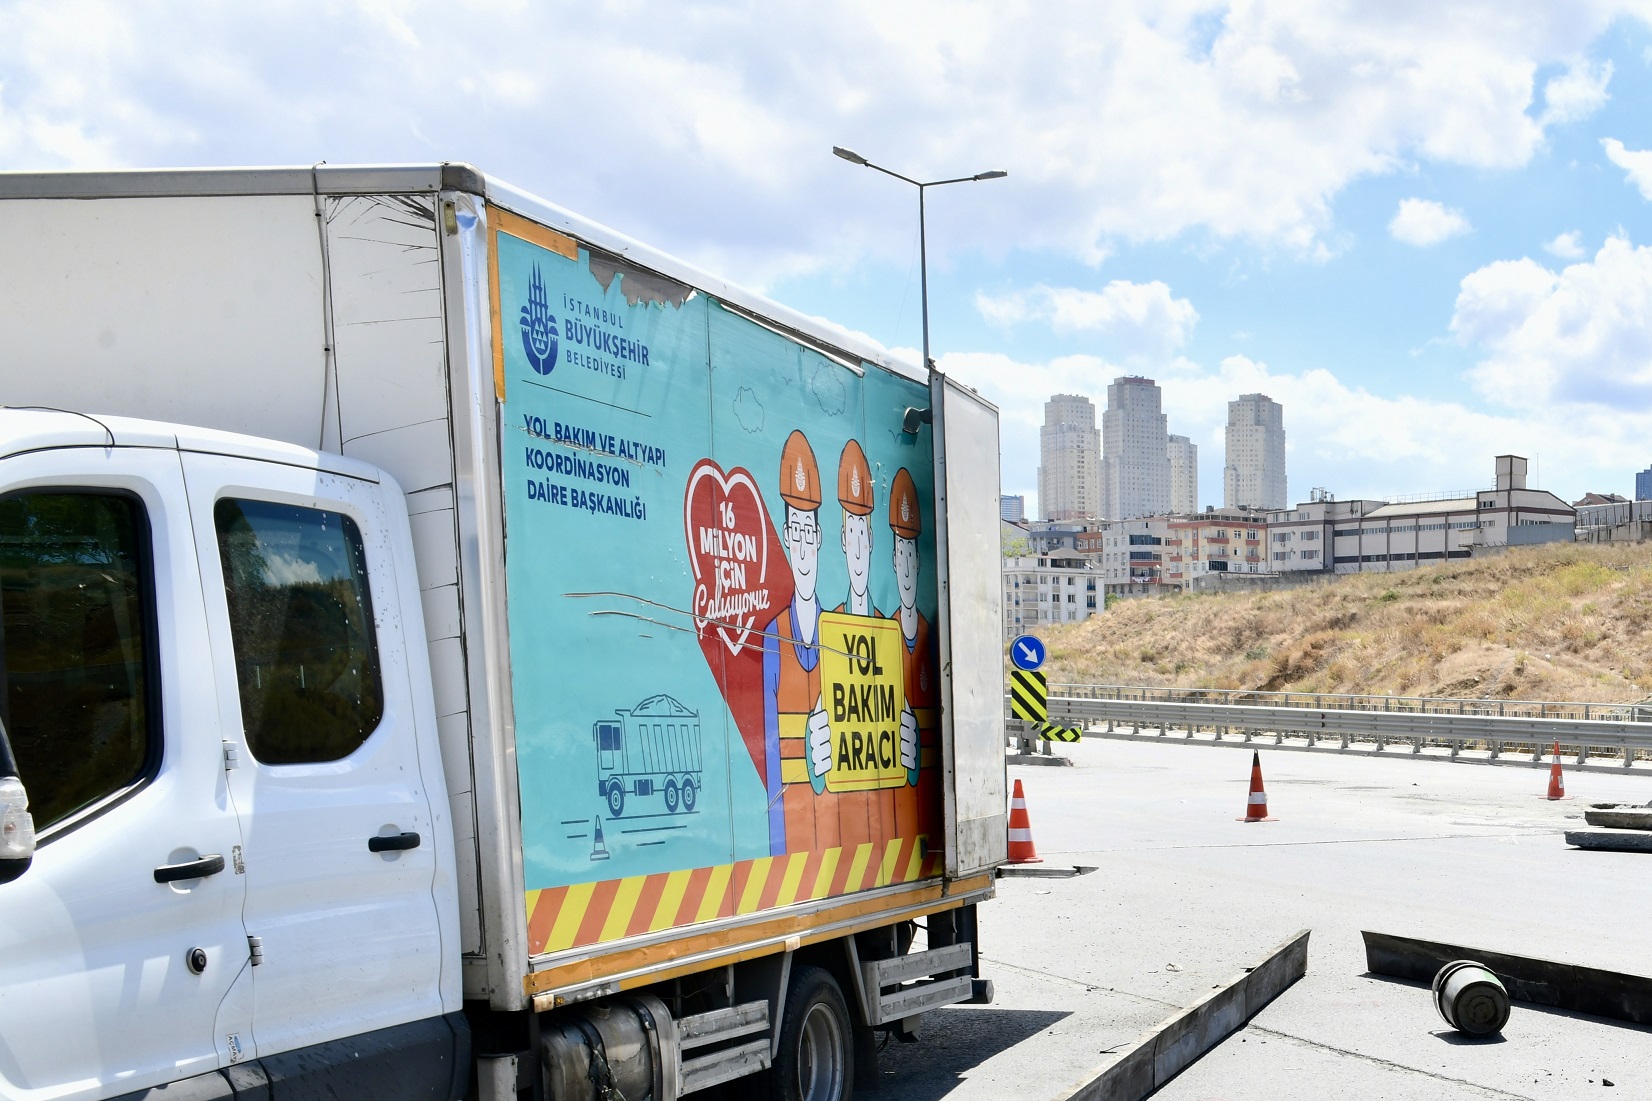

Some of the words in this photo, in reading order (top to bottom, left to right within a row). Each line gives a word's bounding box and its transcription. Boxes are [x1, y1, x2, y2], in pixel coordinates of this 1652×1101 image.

[563, 293, 624, 329] İSTANBUL
[565, 317, 650, 366] BÜYÜKŞEHİR
[566, 349, 626, 380] BELEDİYESİ
[524, 414, 551, 438] YOL
[554, 421, 596, 449] BAKIM
[599, 433, 616, 454] VE
[619, 439, 666, 467] ALTYAPI
[525, 447, 630, 488] KOORDİNASYON
[527, 478, 567, 505] DAİRE
[570, 488, 647, 521] BAŞKANLIĞI
[720, 501, 736, 529] 16
[842, 633, 883, 676] YOL
[833, 682, 896, 723] BAKIM
[837, 730, 897, 772] ARACI
